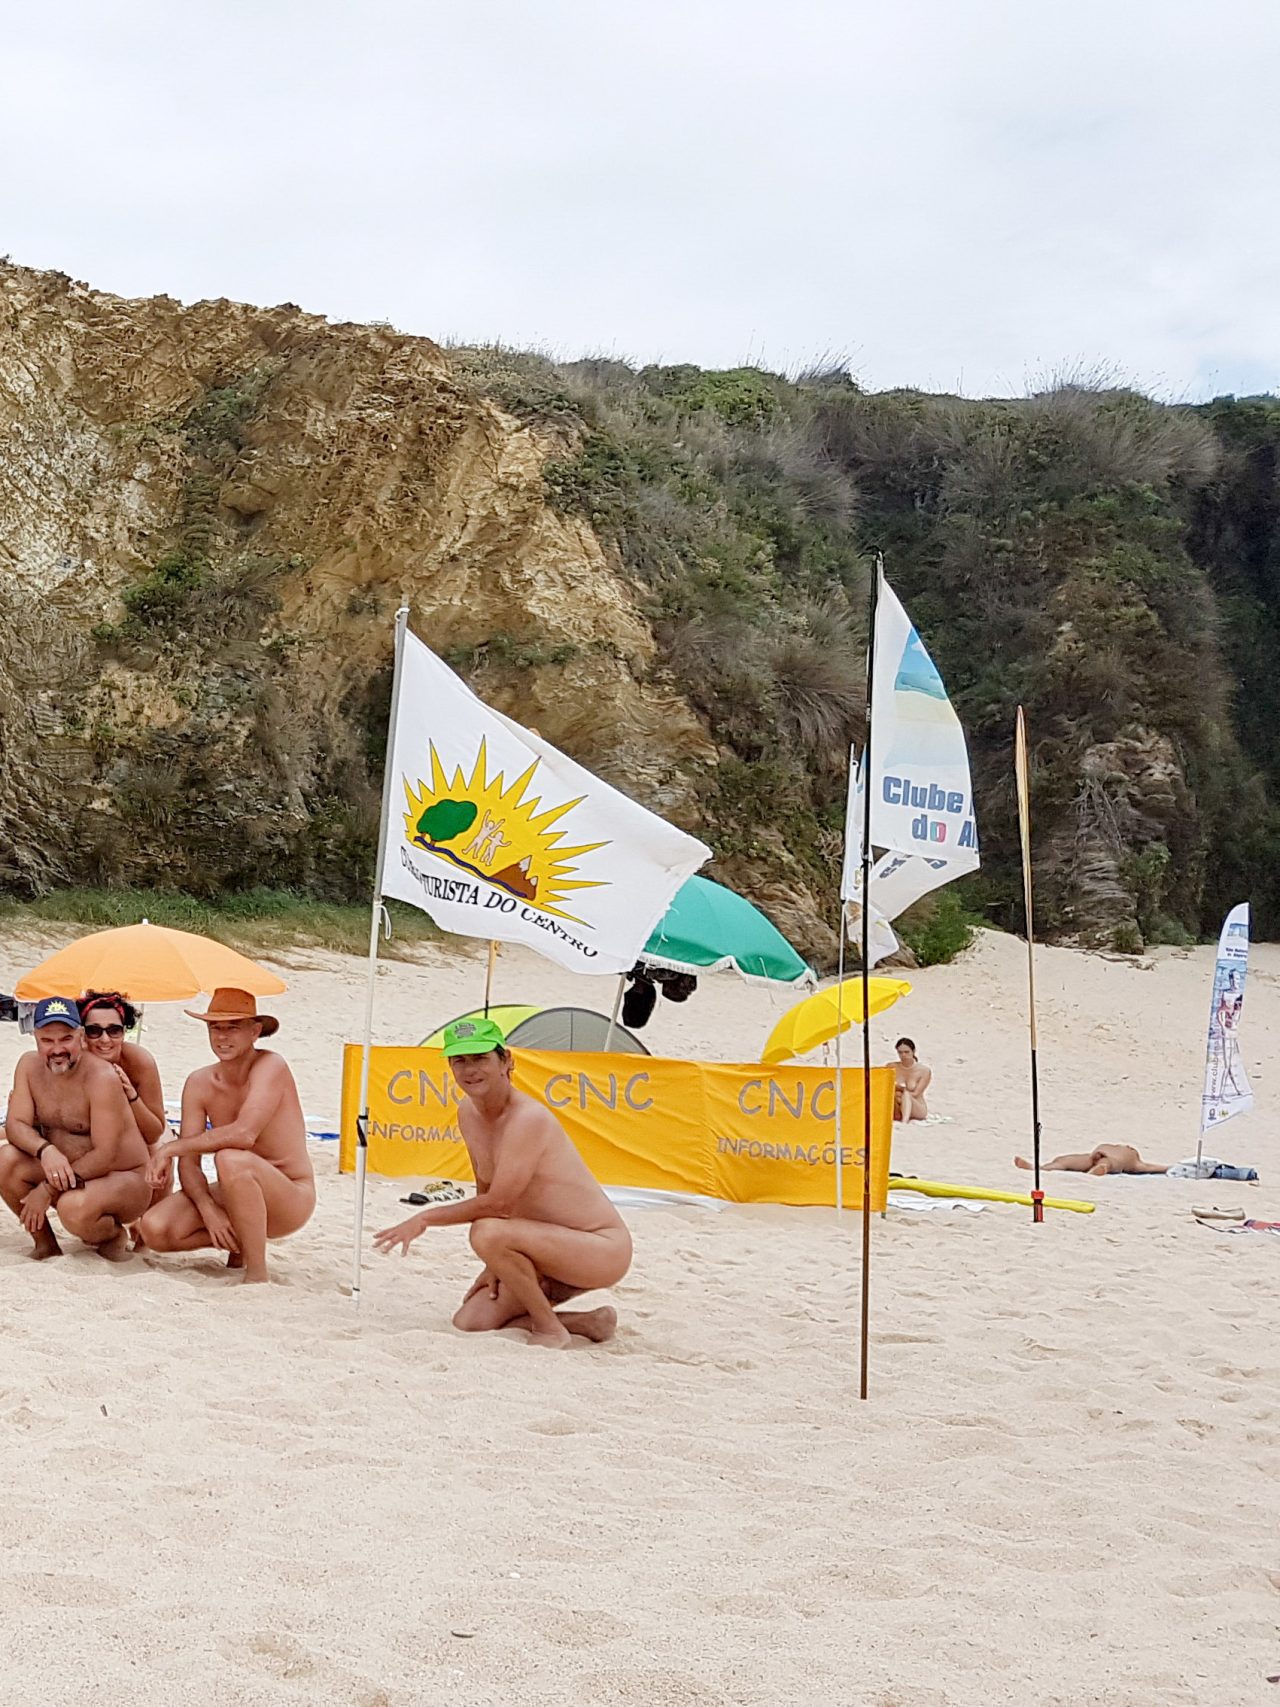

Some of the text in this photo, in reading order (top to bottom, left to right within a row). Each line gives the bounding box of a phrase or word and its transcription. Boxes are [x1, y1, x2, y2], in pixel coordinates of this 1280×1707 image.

[882, 775, 964, 814] Clube
[912, 814, 947, 843] do
[483, 890, 517, 914] DO
[521, 907, 599, 958] CENTRO
[544, 1071, 654, 1111] CNC
[738, 1078, 837, 1121] CNC
[716, 1136, 866, 1167] INFORMAÇÕES
